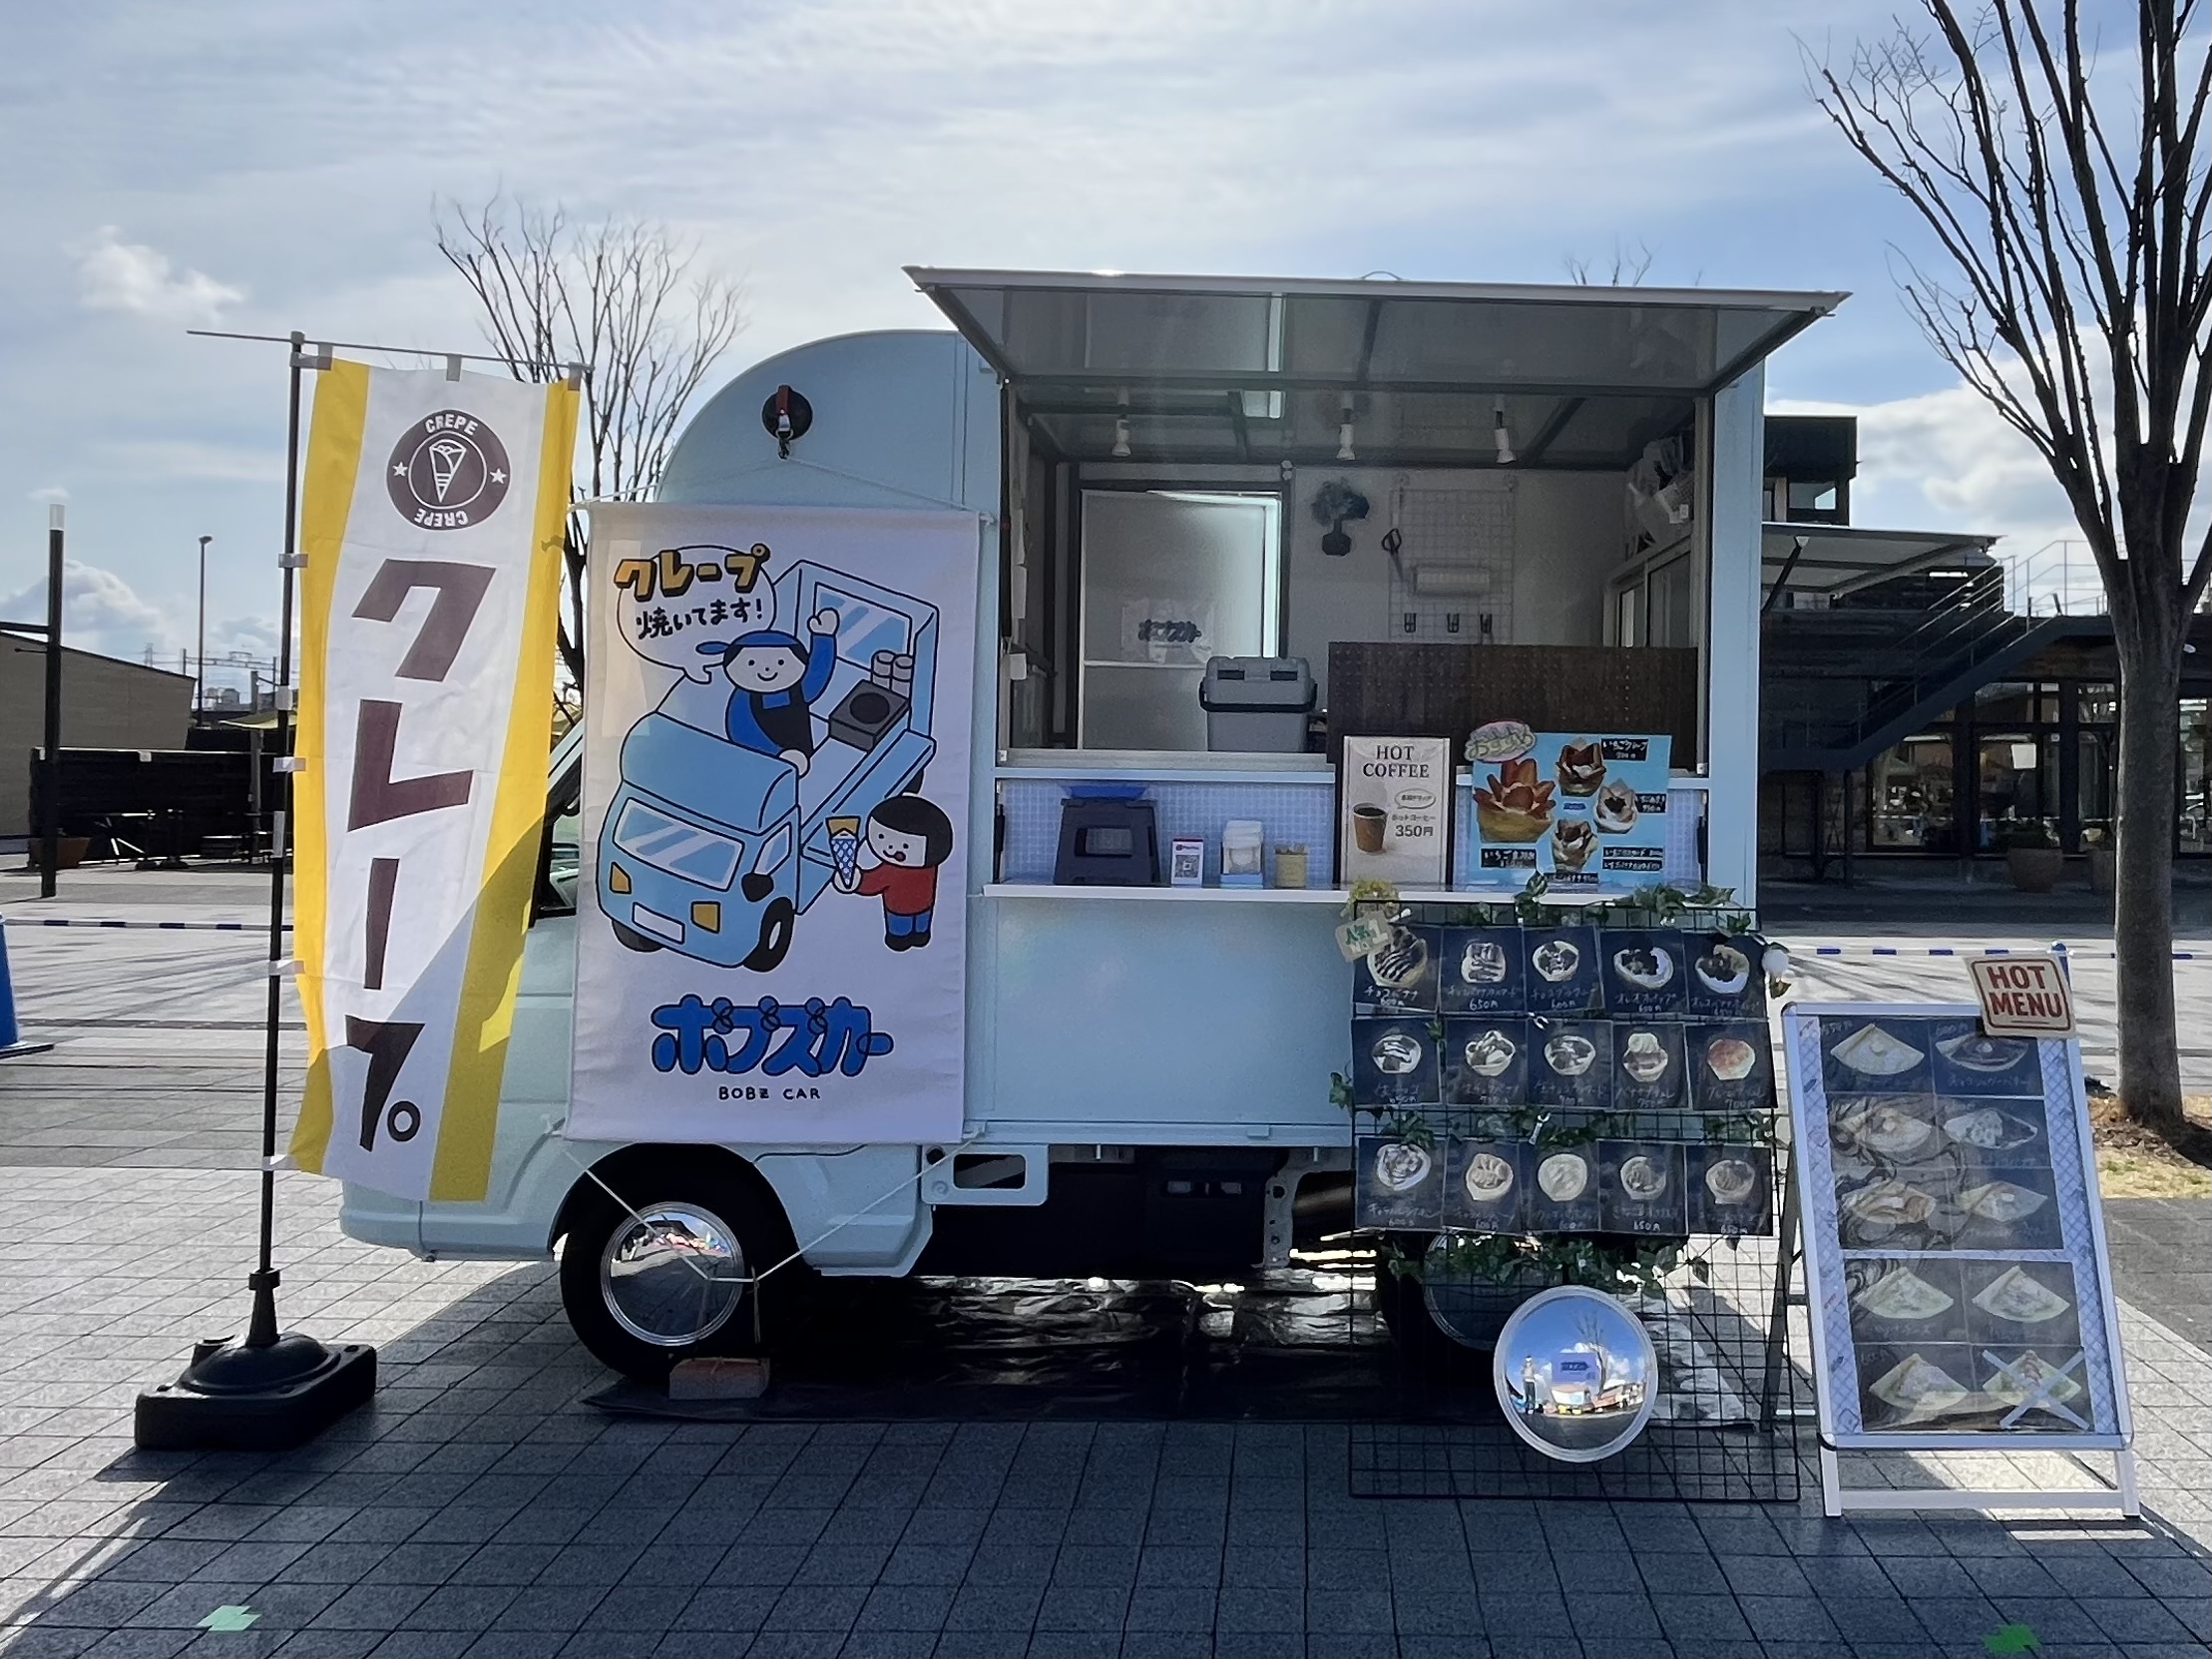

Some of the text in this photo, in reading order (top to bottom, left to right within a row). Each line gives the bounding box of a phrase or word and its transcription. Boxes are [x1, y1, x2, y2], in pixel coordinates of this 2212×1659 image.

[424, 413, 479, 436] CREPE
[413, 508, 469, 528] CREPE
[613, 543, 771, 604] クレープ
[636, 597, 762, 640] 焼いてます!
[1377, 744, 1415, 761] HOT
[1362, 762, 1430, 778] COFFEE
[1394, 824, 1434, 838] 350円
[1986, 965, 2046, 990] HOT
[1470, 998, 1499, 1011] 650円
[1989, 992, 2063, 1018] MENU
[651, 994, 895, 1077] ボブズカー
[782, 1087, 821, 1100] CAR
[1633, 1219, 1661, 1232] 650円
